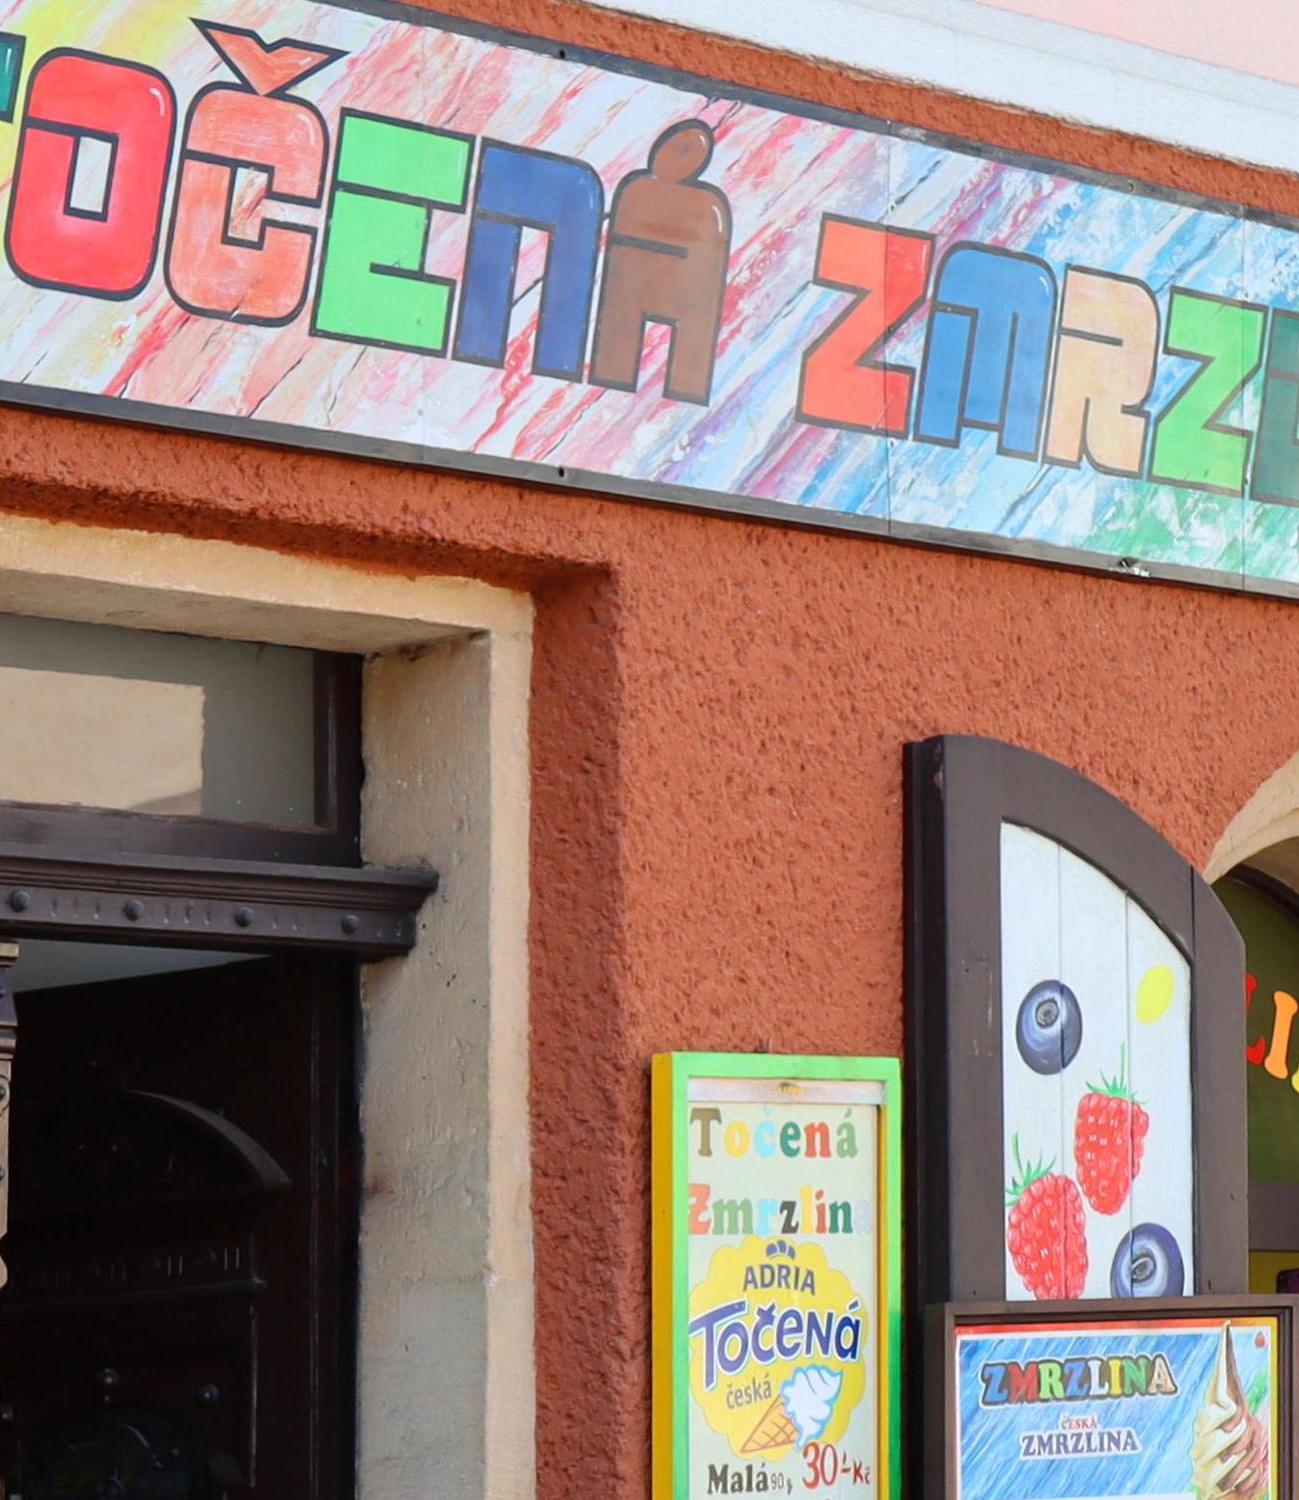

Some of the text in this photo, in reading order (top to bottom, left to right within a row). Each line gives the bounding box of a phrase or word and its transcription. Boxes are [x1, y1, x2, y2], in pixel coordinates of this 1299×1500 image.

[743, 1264, 816, 1296] ADRIA
[689, 1299, 861, 1389] Točená
[726, 1373, 772, 1409] česká
[981, 1354, 1178, 1406] ZMRZLINA
[1021, 1429, 1139, 1457] ZMRZLINA
[707, 1462, 769, 1495] Malá
